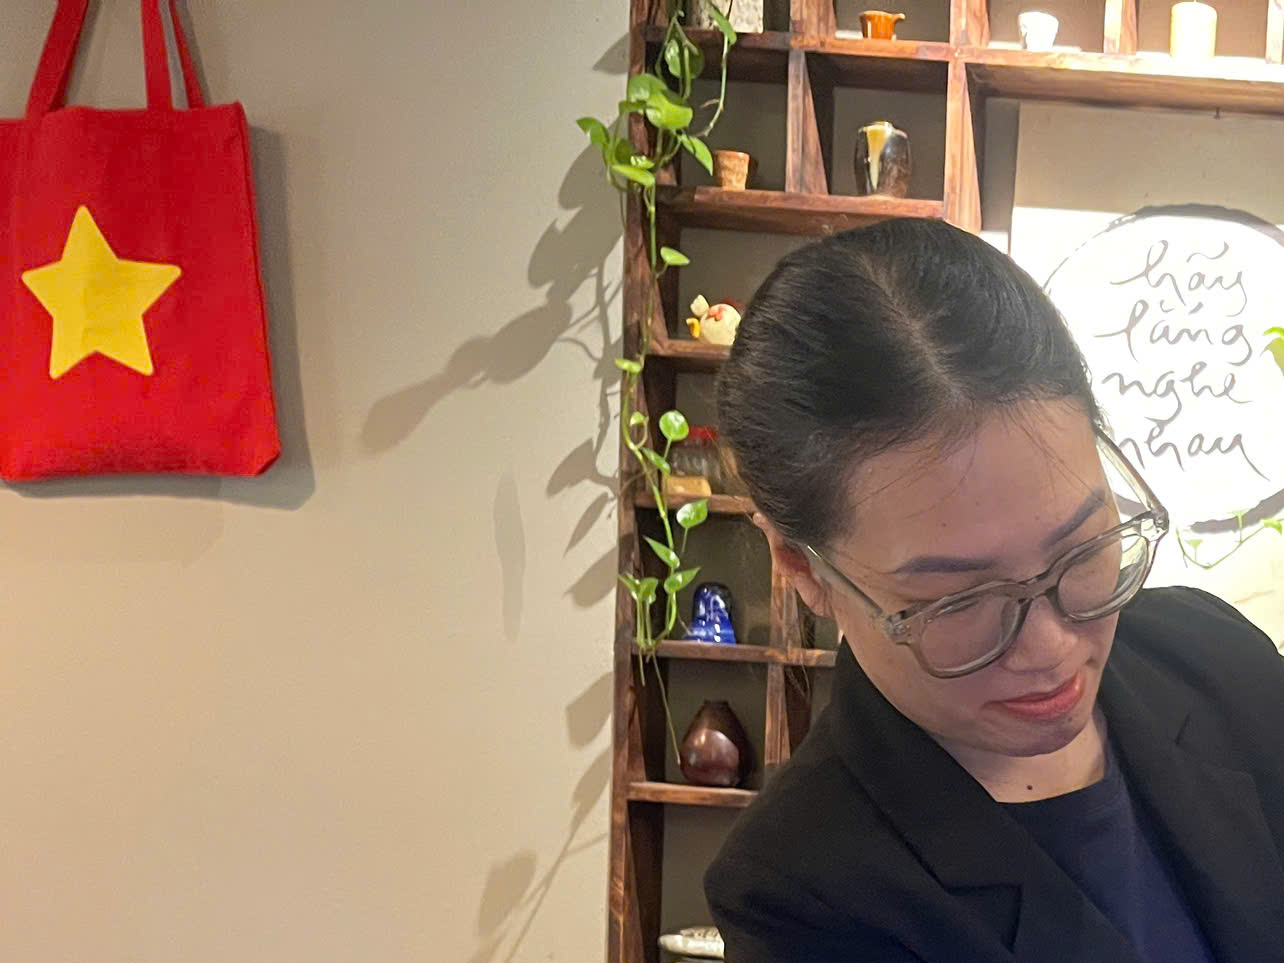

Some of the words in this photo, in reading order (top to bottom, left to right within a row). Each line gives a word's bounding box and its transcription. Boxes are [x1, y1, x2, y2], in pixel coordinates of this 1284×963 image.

[1110, 239, 1247, 317] hãy
[1094, 299, 1252, 366] lắng
[1102, 361, 1253, 425] nghe
